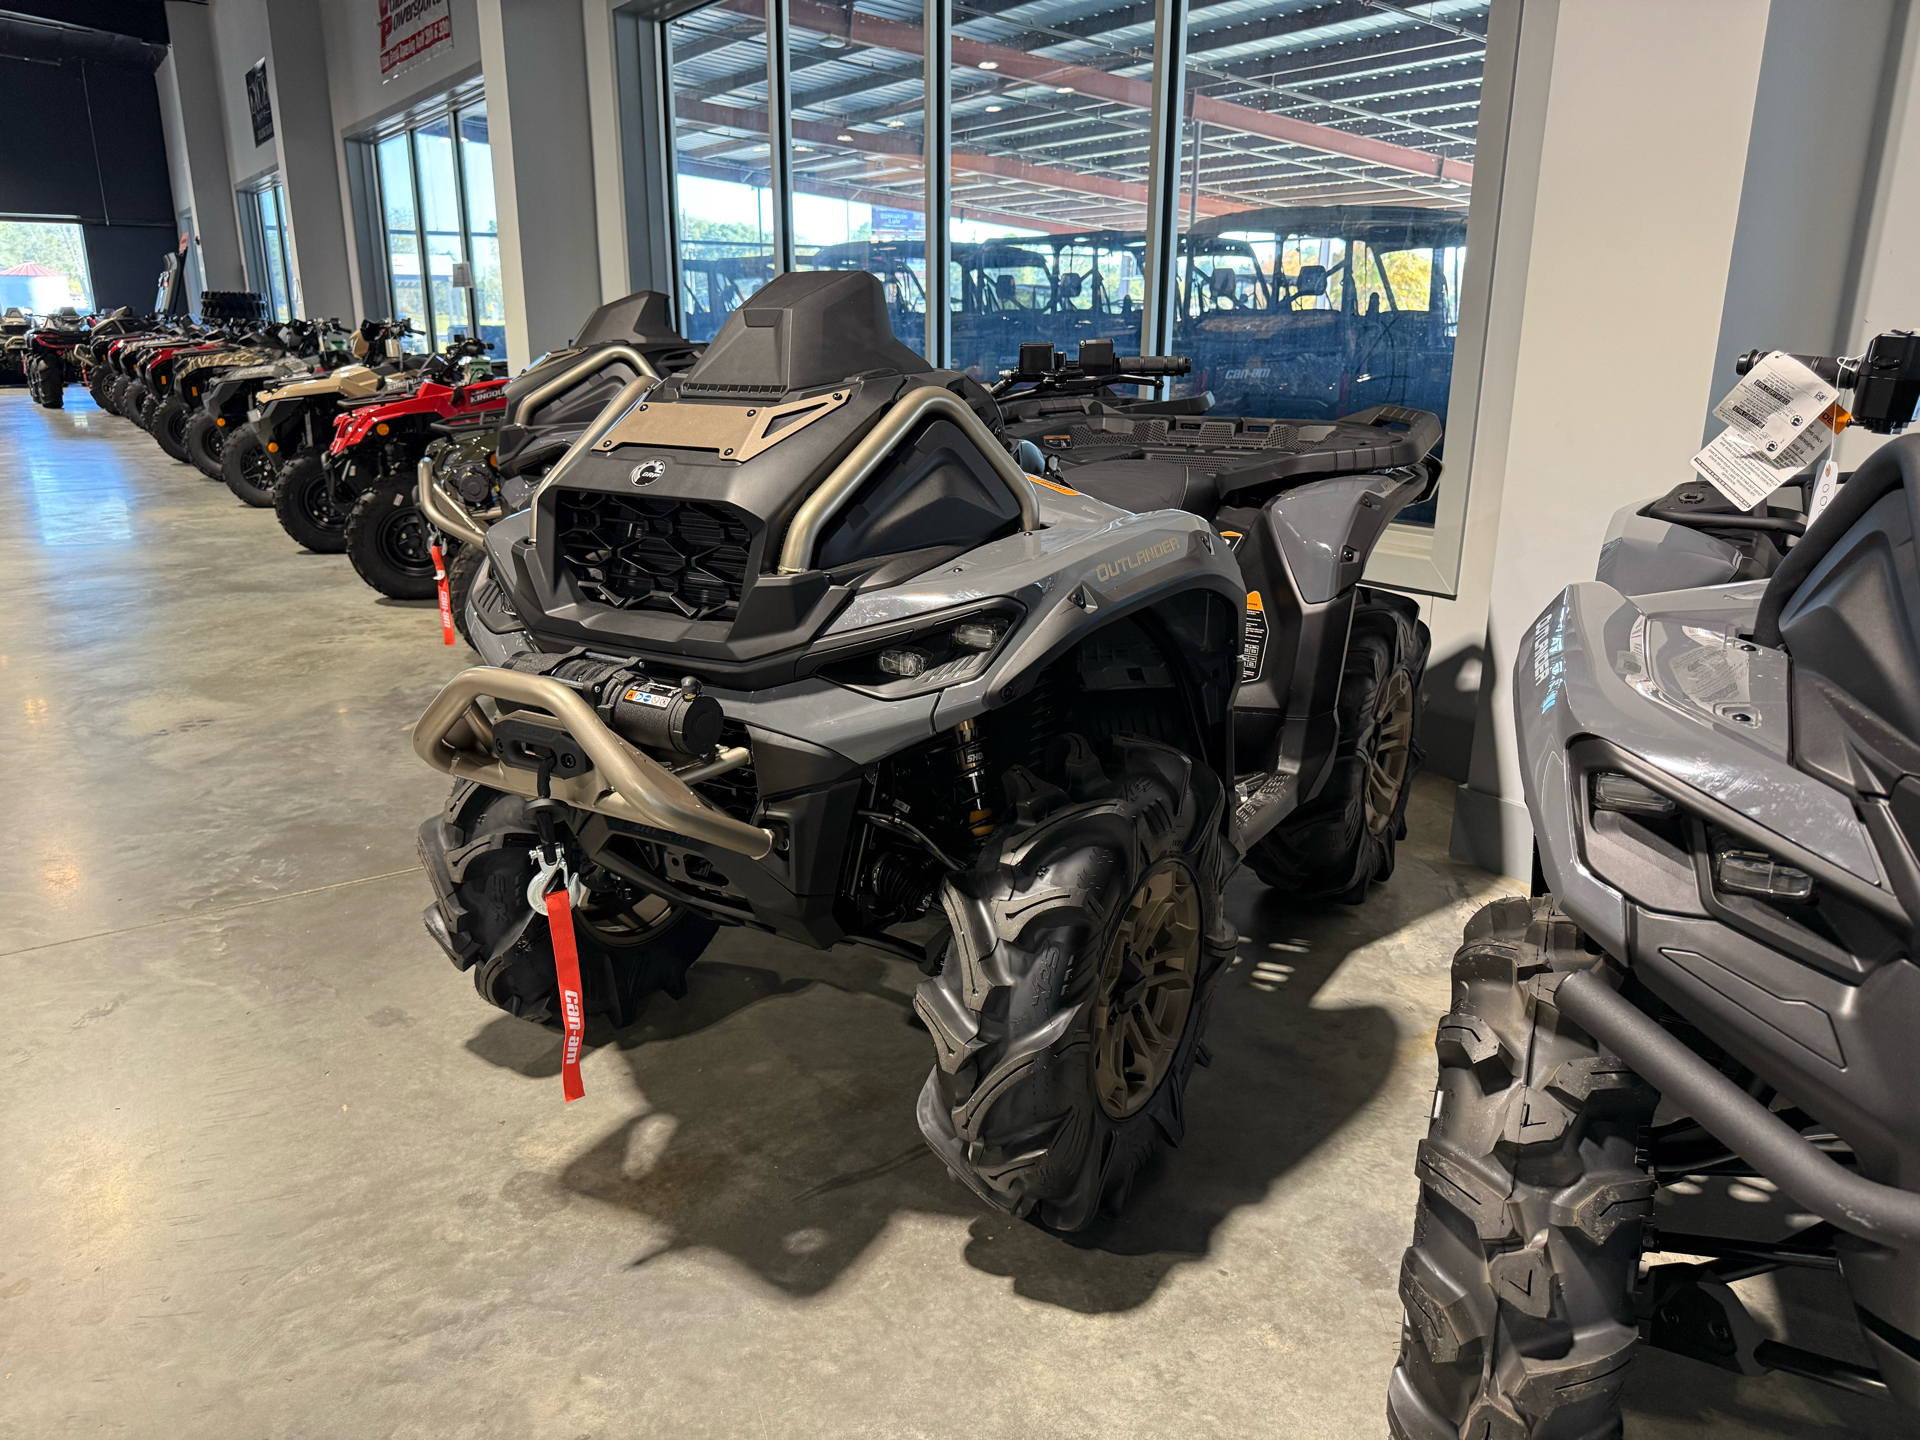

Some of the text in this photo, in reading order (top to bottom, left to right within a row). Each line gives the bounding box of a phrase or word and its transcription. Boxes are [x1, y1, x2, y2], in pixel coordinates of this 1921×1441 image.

[1224, 367, 1271, 380] can-am
[1096, 537, 1180, 582] OUTLANDER
[440, 590, 451, 628] can-am
[1534, 614, 1553, 687] OUTLANDER
[564, 990, 581, 1064] can-am
